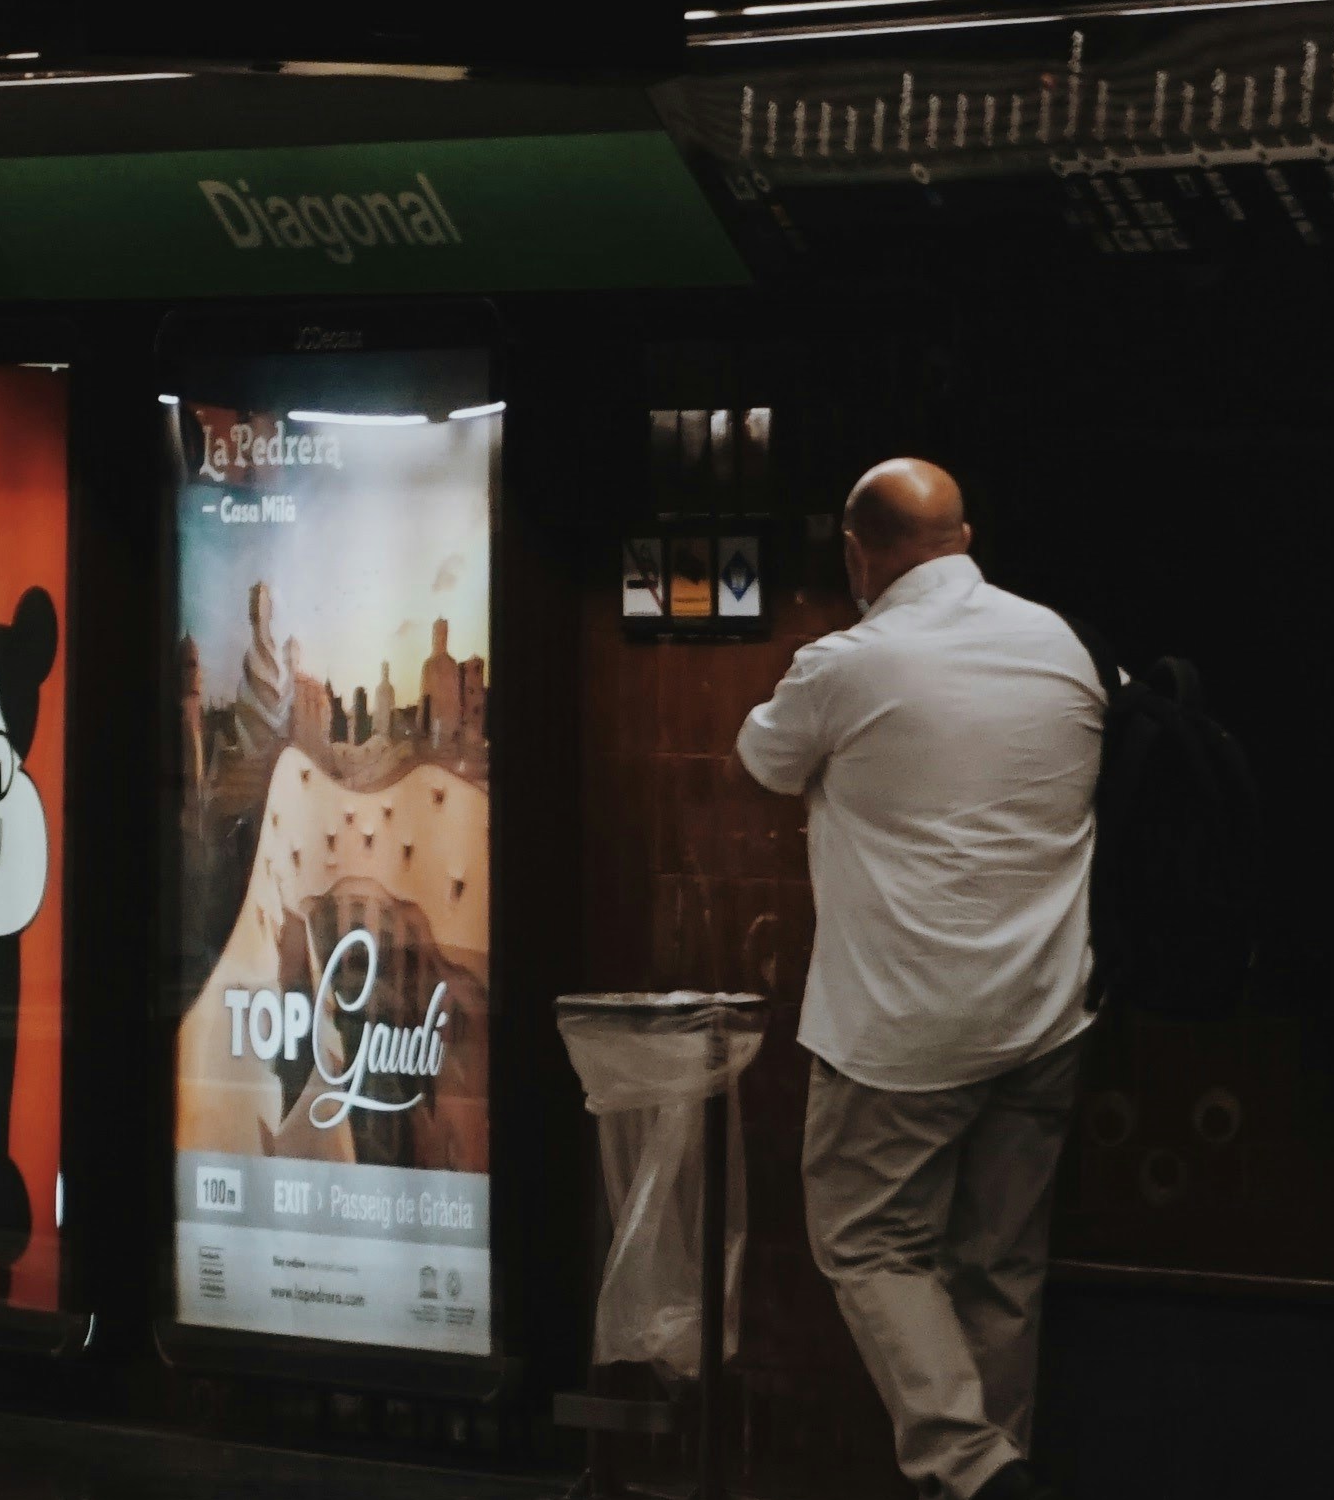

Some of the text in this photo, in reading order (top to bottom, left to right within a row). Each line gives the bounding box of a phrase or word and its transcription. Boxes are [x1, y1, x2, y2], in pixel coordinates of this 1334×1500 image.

[198, 171, 463, 264] Diagonal
[199, 420, 344, 482] La Pedrera
[220, 495, 259, 523] Casa
[224, 989, 312, 1061] TOP
[274, 1179, 312, 1216] EXIT
[330, 1185, 392, 1229] Passeig
[396, 1192, 416, 1224] de
[419, 1191, 474, 1230] Gràcia
